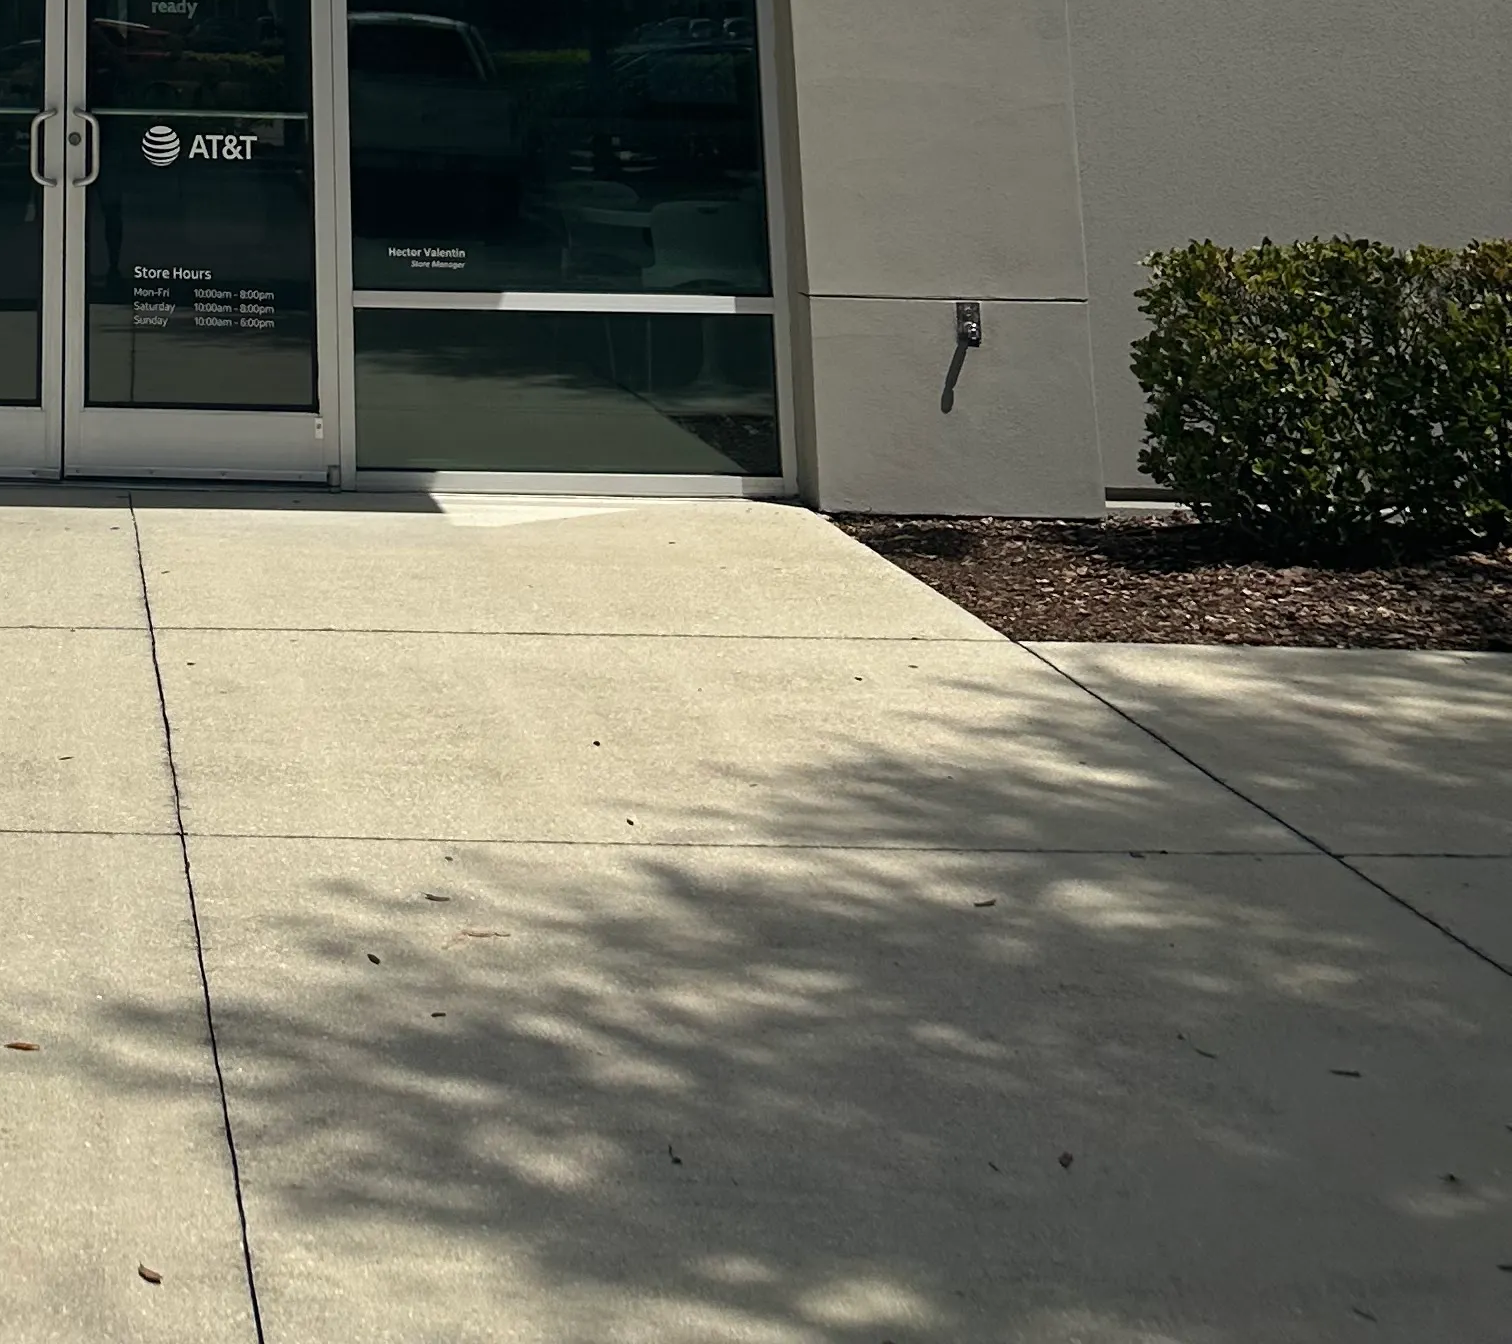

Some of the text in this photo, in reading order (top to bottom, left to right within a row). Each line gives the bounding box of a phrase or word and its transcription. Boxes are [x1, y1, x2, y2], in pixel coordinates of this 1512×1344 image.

[151, 0, 199, 19] ready
[188, 134, 258, 160] AT&T
[388, 247, 466, 258] Hector Valentin
[431, 261, 465, 269] Manager
[134, 266, 212, 280] Store Hours
[133, 287, 170, 298] Mon-Fri
[194, 288, 232, 299] 10:00am
[239, 289, 274, 301] 8:00pm
[133, 301, 176, 314] Saturday
[194, 302, 232, 313] 10:00am
[239, 303, 274, 315] 8:00pm
[133, 315, 169, 327] Sunday
[194, 316, 233, 327] 10:00am
